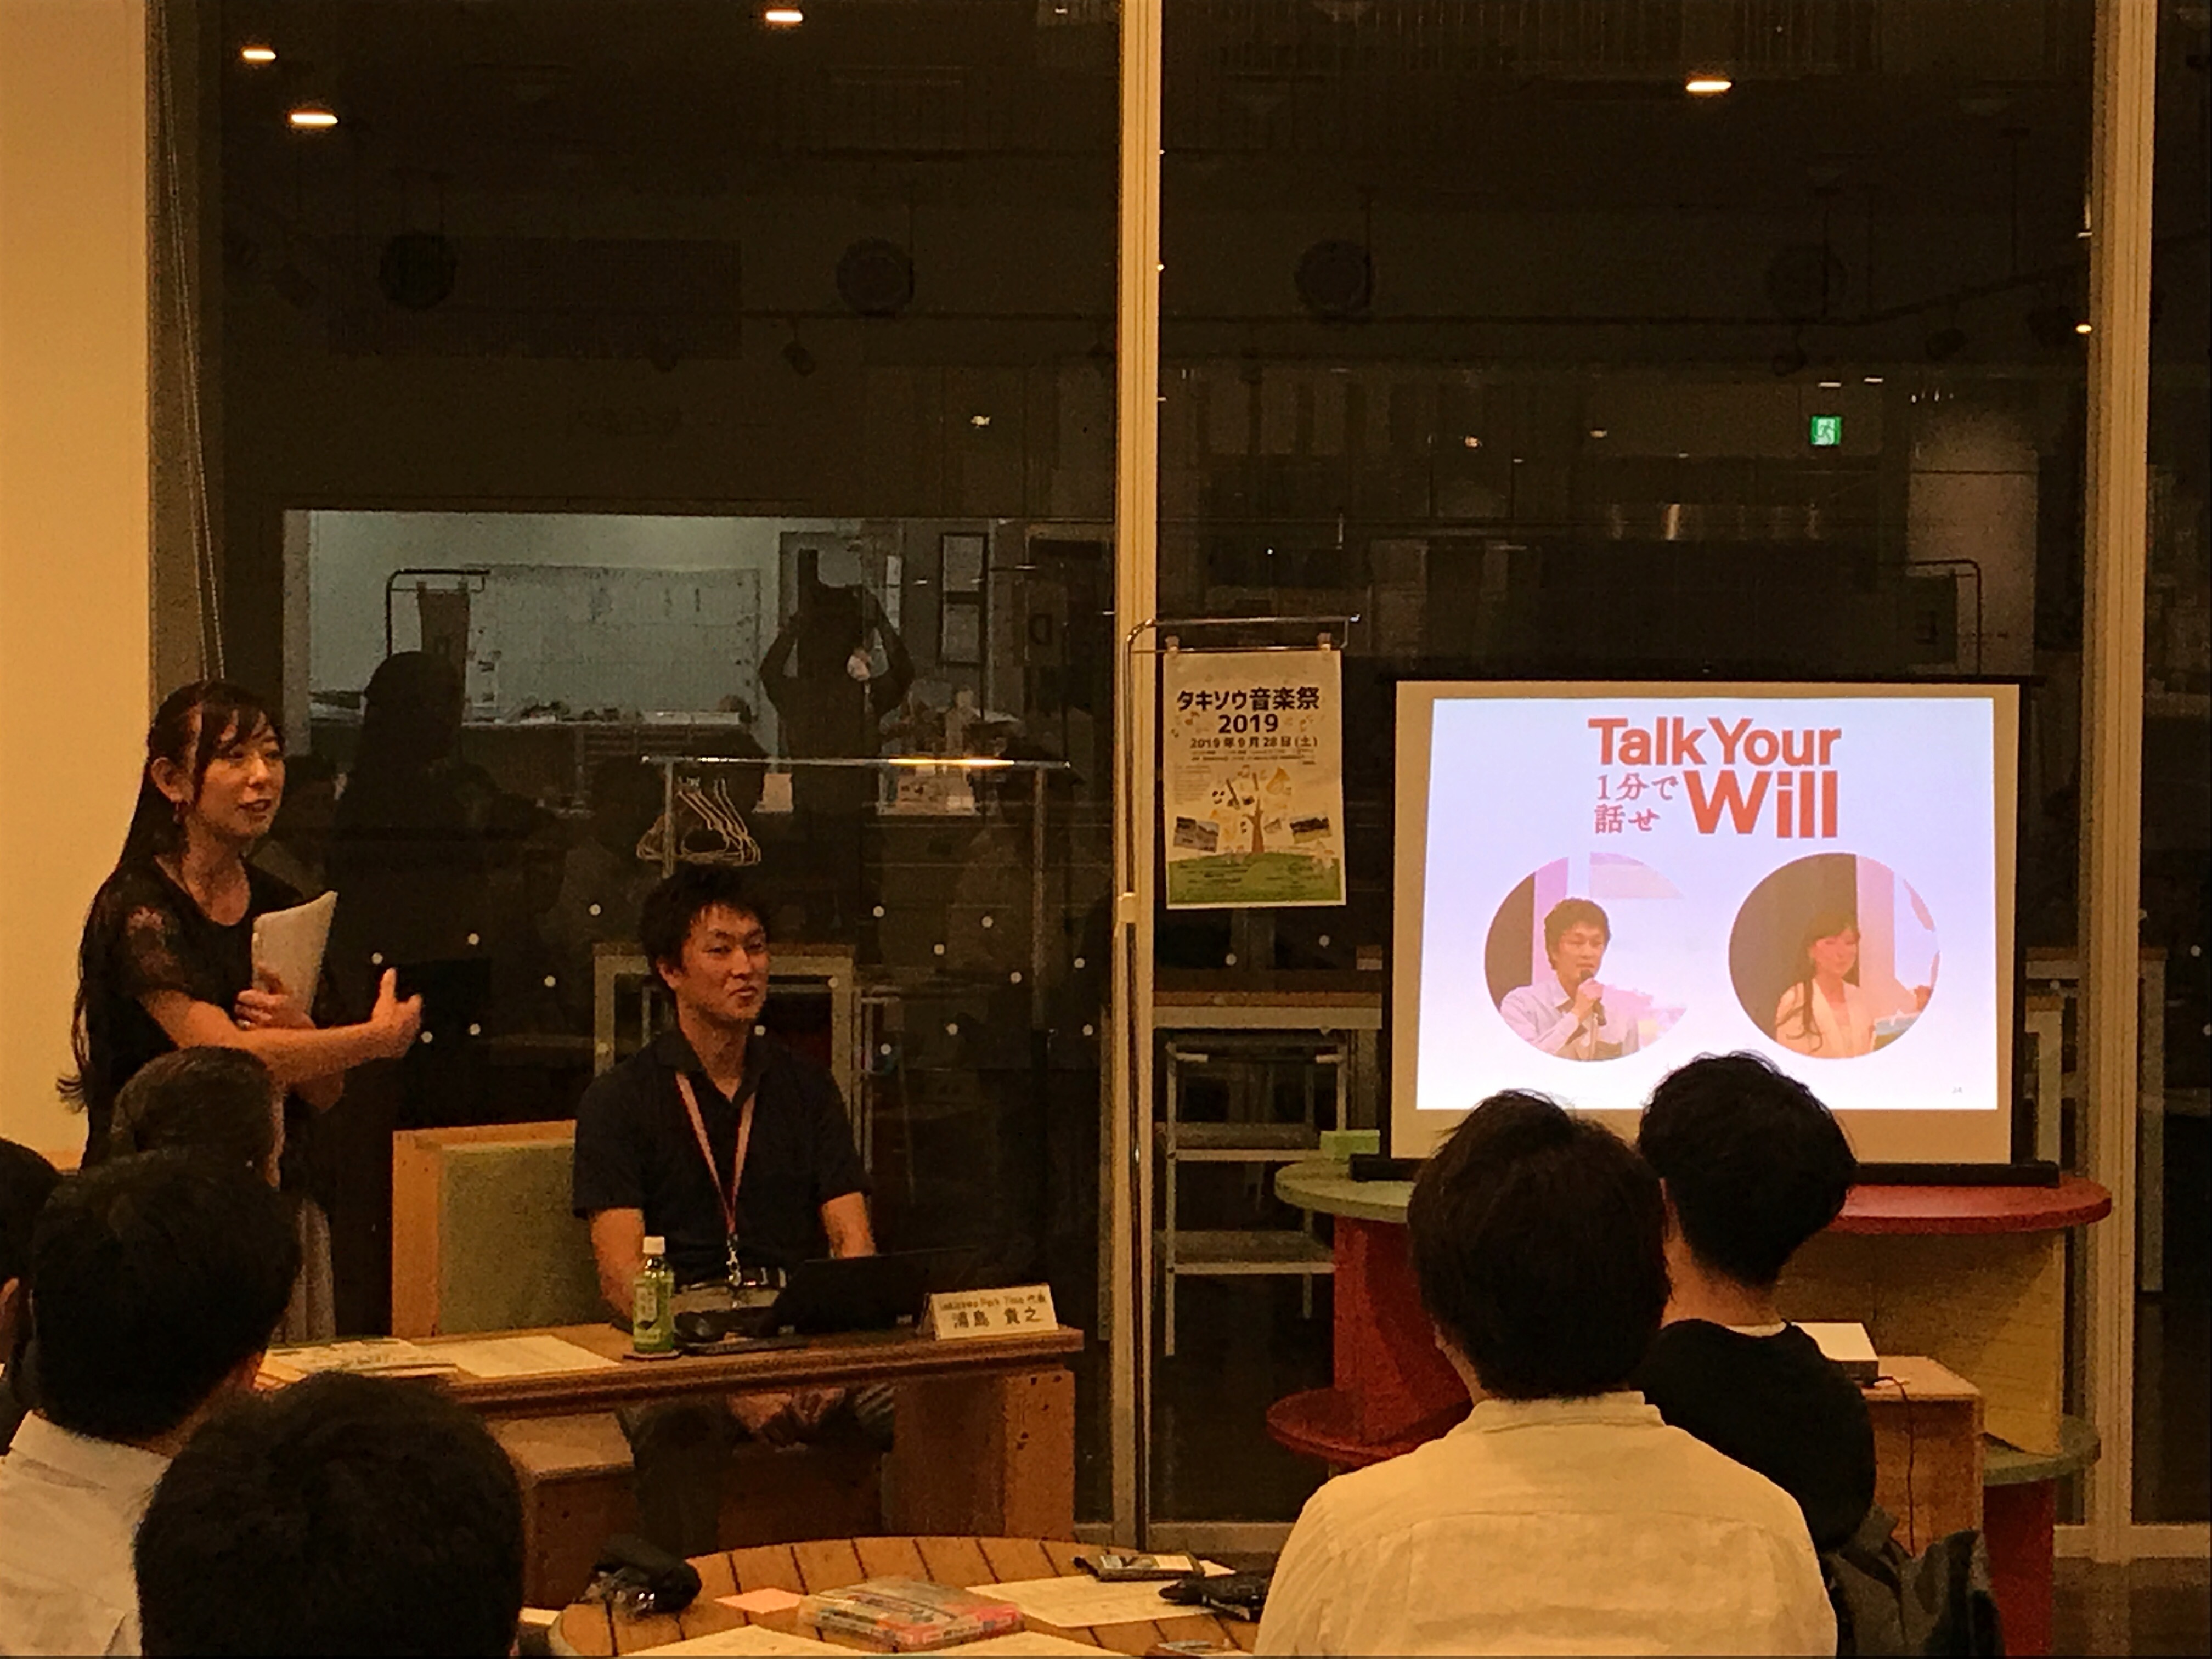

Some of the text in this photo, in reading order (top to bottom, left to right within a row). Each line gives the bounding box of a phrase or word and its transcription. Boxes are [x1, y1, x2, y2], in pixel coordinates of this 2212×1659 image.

[1177, 687, 1319, 711] タキソウ音楽祭
[1218, 714, 1278, 733] 2019
[1588, 716, 1842, 766] Talk Your
[1597, 772, 1679, 801] 1分で
[1683, 769, 1838, 838] Will
[1594, 804, 1660, 834] 話せ
